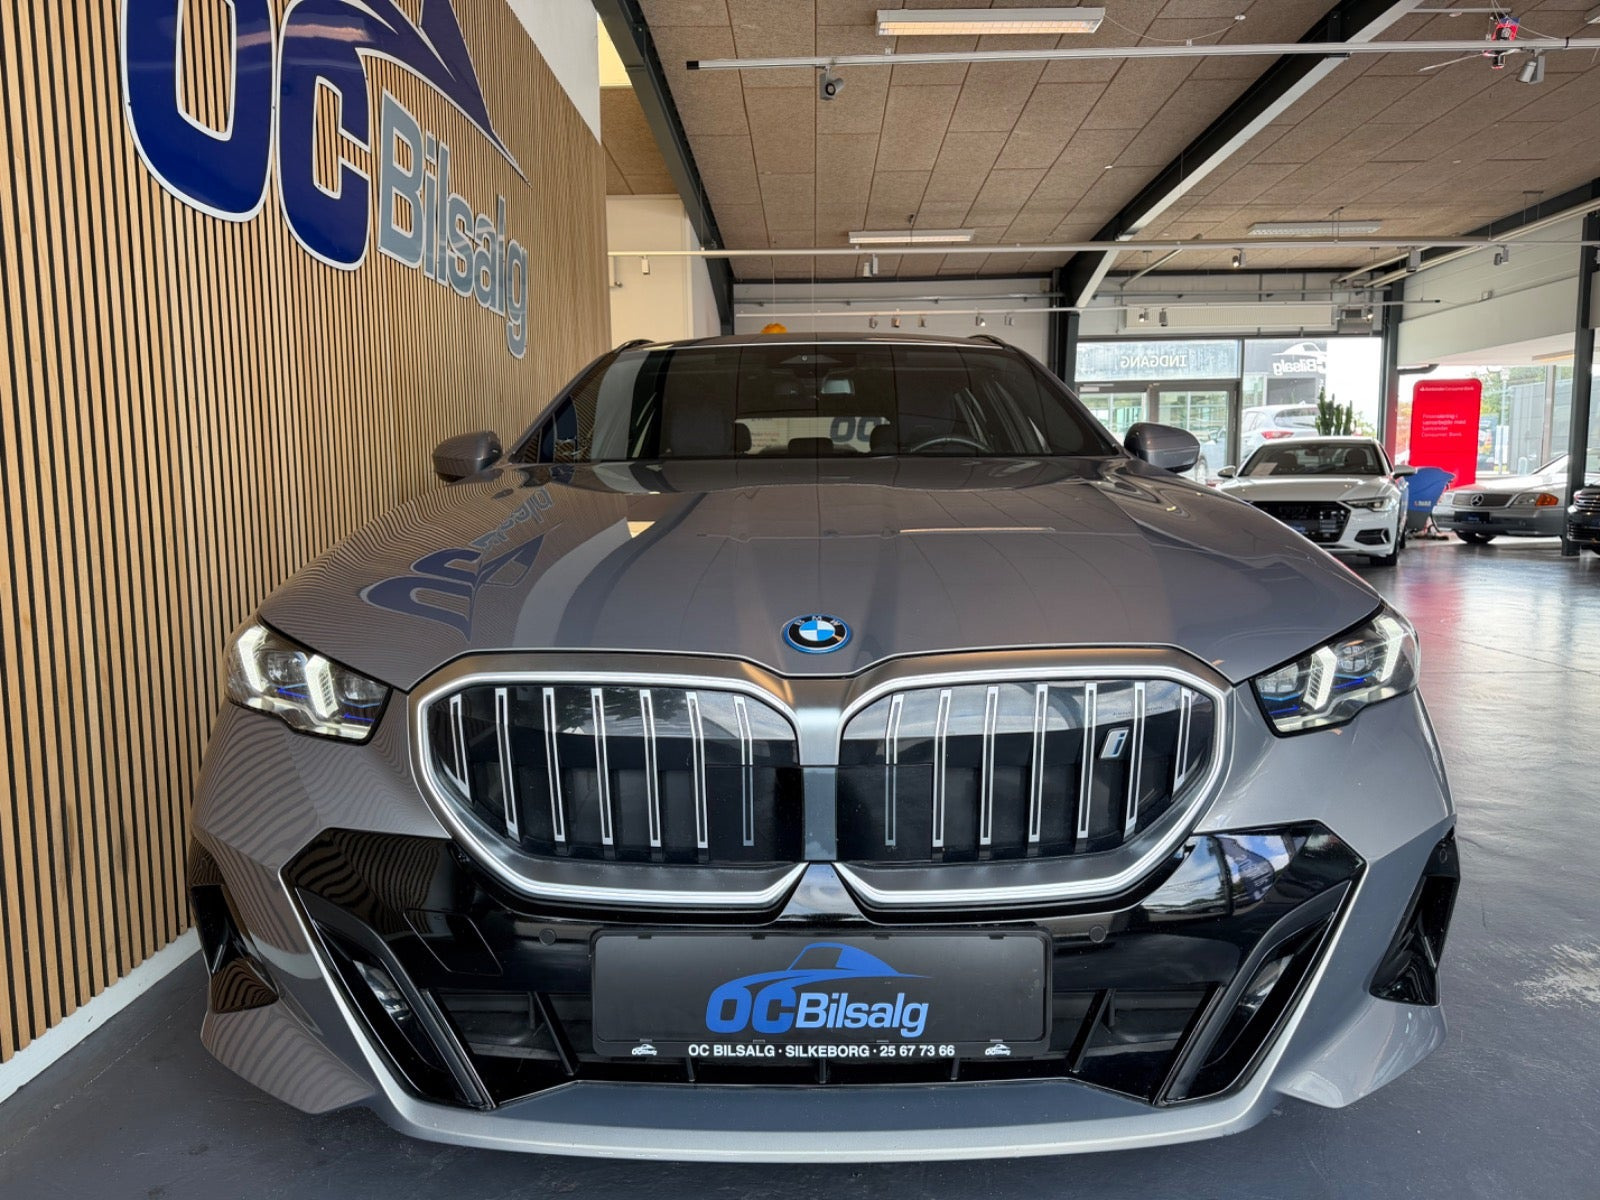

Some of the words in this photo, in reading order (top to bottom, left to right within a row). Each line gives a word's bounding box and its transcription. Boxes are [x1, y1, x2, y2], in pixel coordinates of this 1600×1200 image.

[378, 87, 529, 360] Bilsalg
[794, 615, 841, 626] BMW
[795, 992, 929, 1038] Bilsalg
[687, 1043, 710, 1057] OC
[713, 1044, 775, 1058] BILSALG
[785, 1044, 870, 1058] SILKEBORG
[879, 1044, 896, 1057] 25
[899, 1044, 915, 1057] 67
[919, 1044, 935, 1057] 73
[938, 1044, 956, 1057] 66
